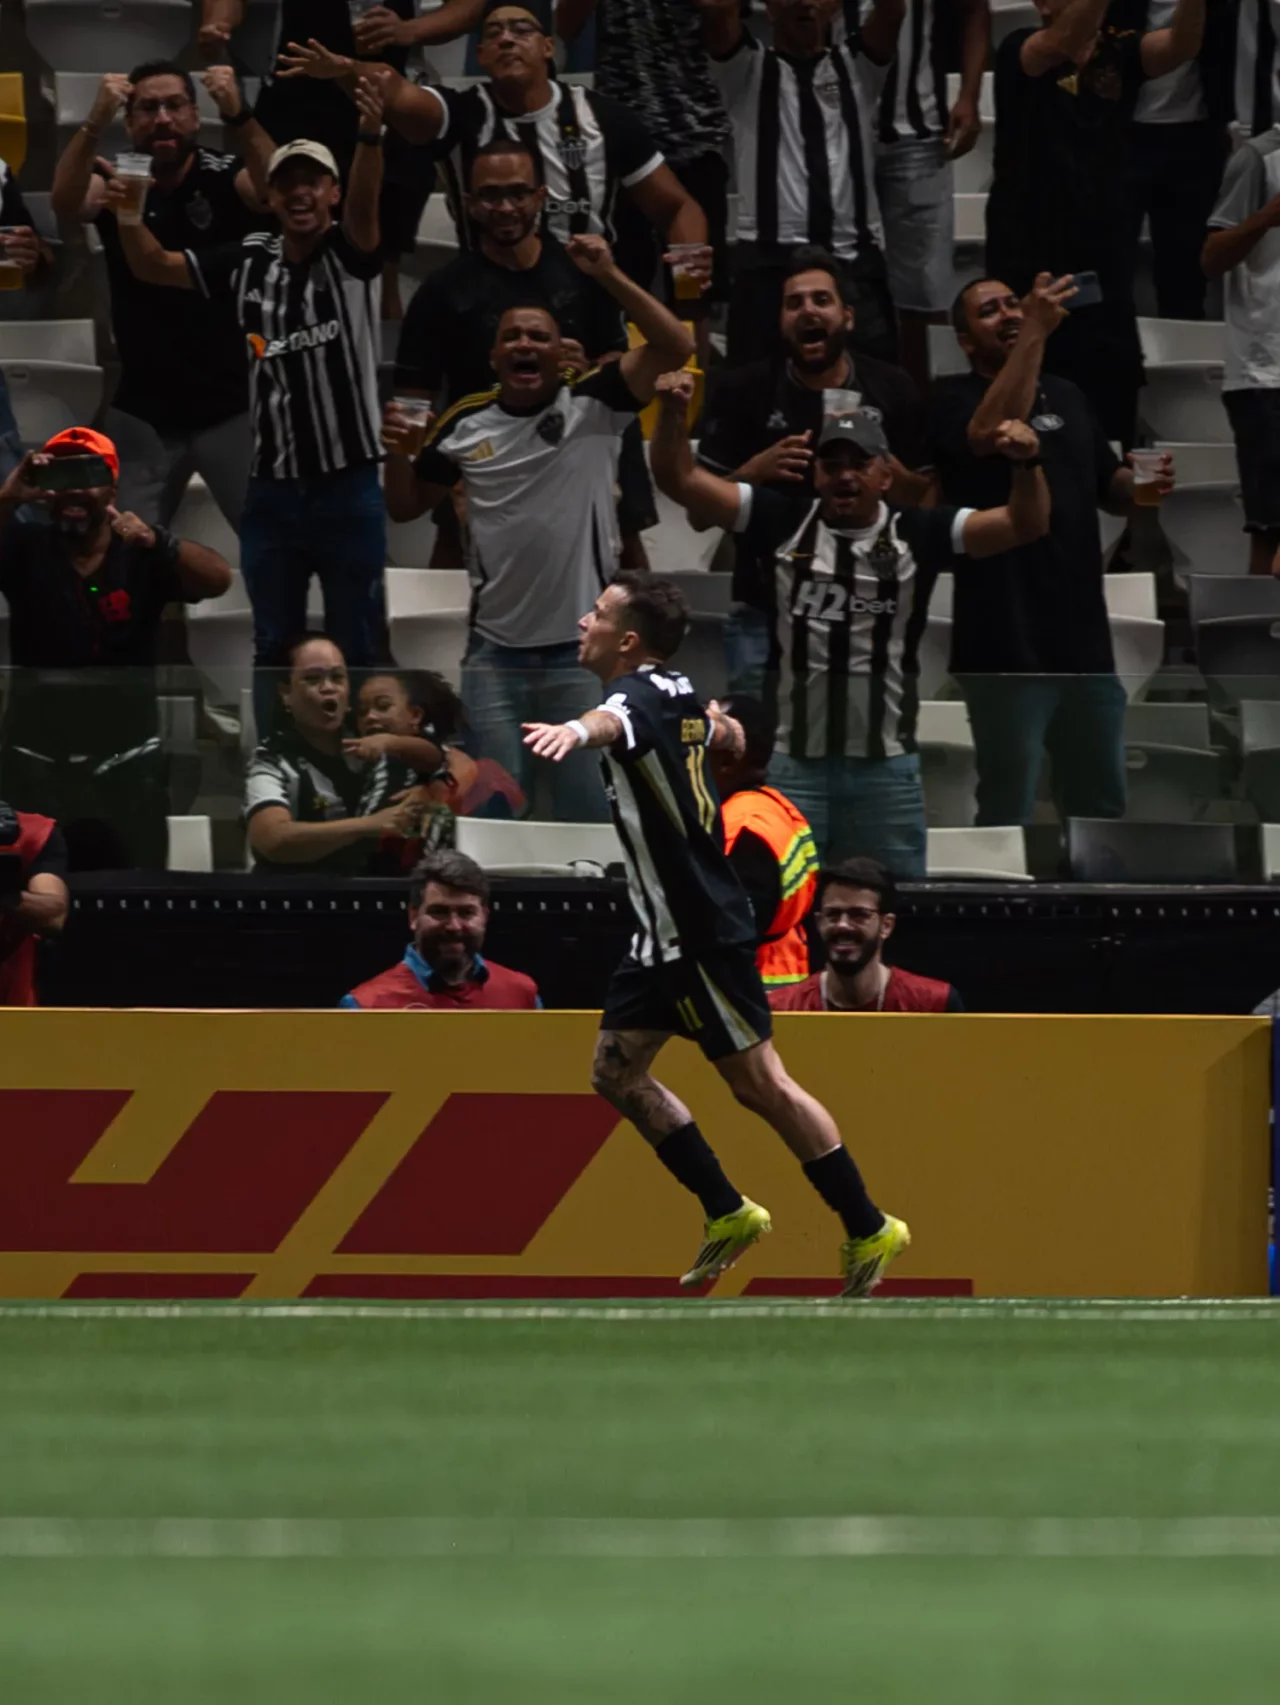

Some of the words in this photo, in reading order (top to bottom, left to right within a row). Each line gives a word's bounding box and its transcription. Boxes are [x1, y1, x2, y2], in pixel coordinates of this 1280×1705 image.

[263, 319, 339, 358] BETANO
[685, 744, 717, 835] 11
[676, 995, 705, 1033] 11
